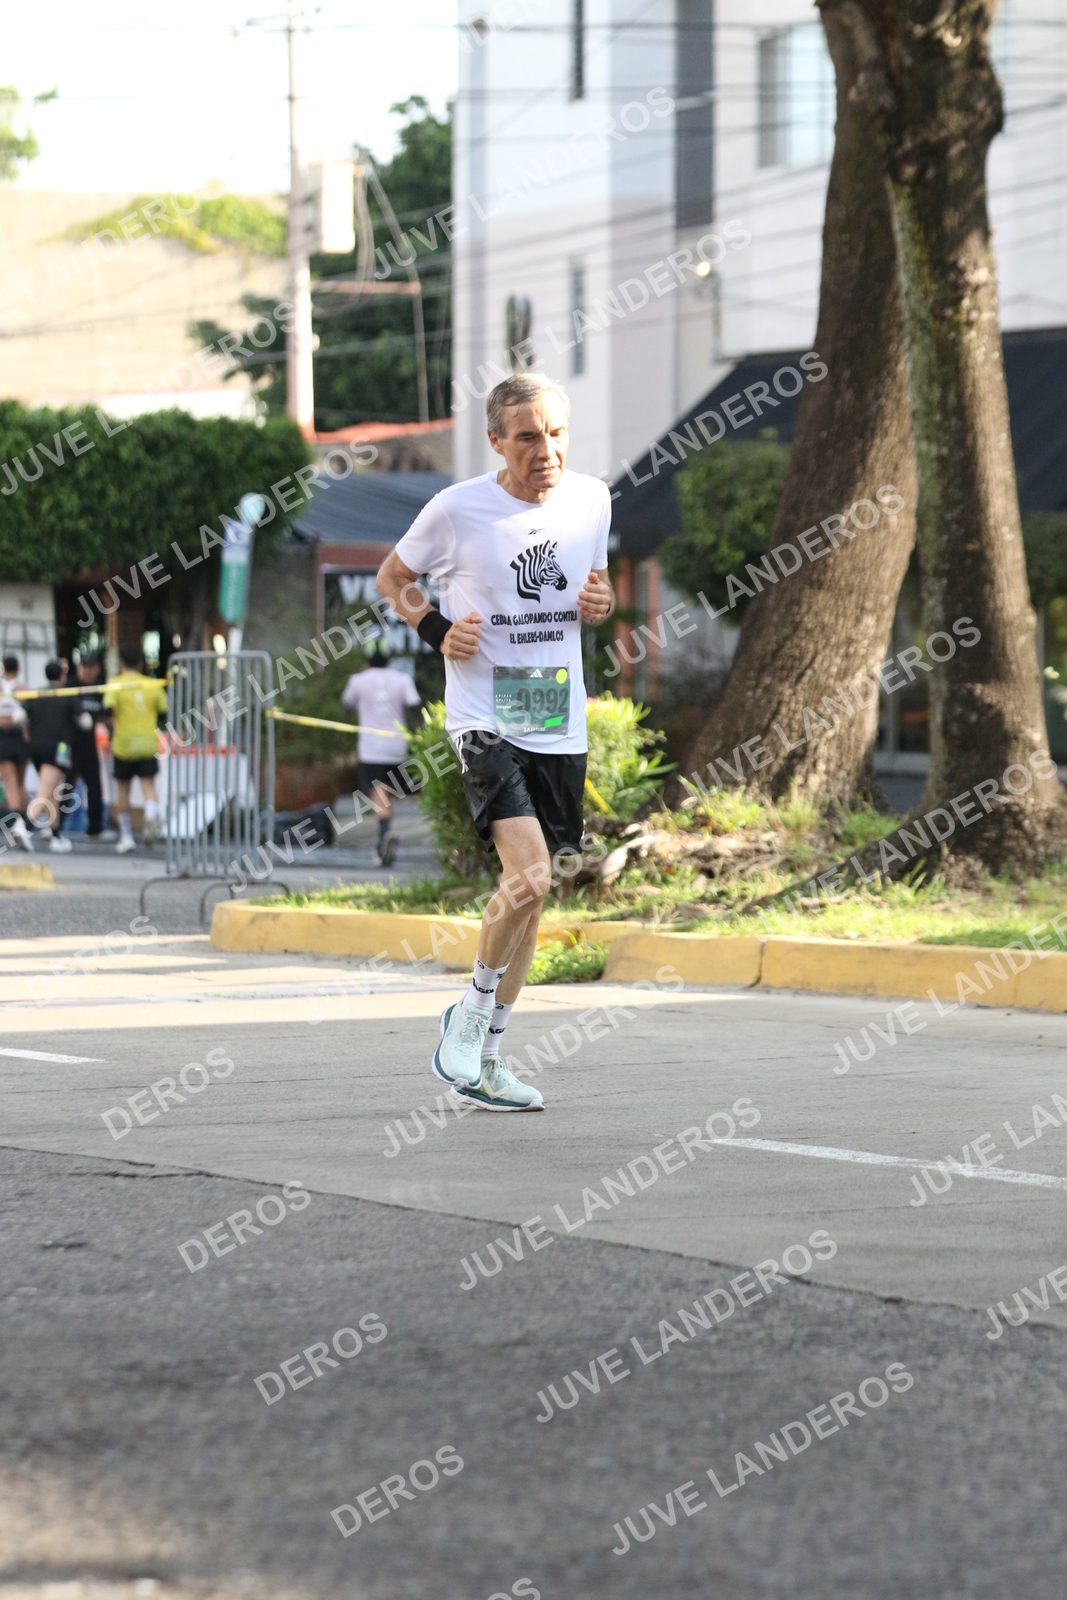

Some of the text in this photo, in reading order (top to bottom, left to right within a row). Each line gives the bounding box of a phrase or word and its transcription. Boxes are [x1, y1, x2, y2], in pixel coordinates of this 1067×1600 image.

[513, 612, 553, 626] GALOPANDO
[509, 633, 517, 644] EL
[517, 688, 569, 713] 0992
